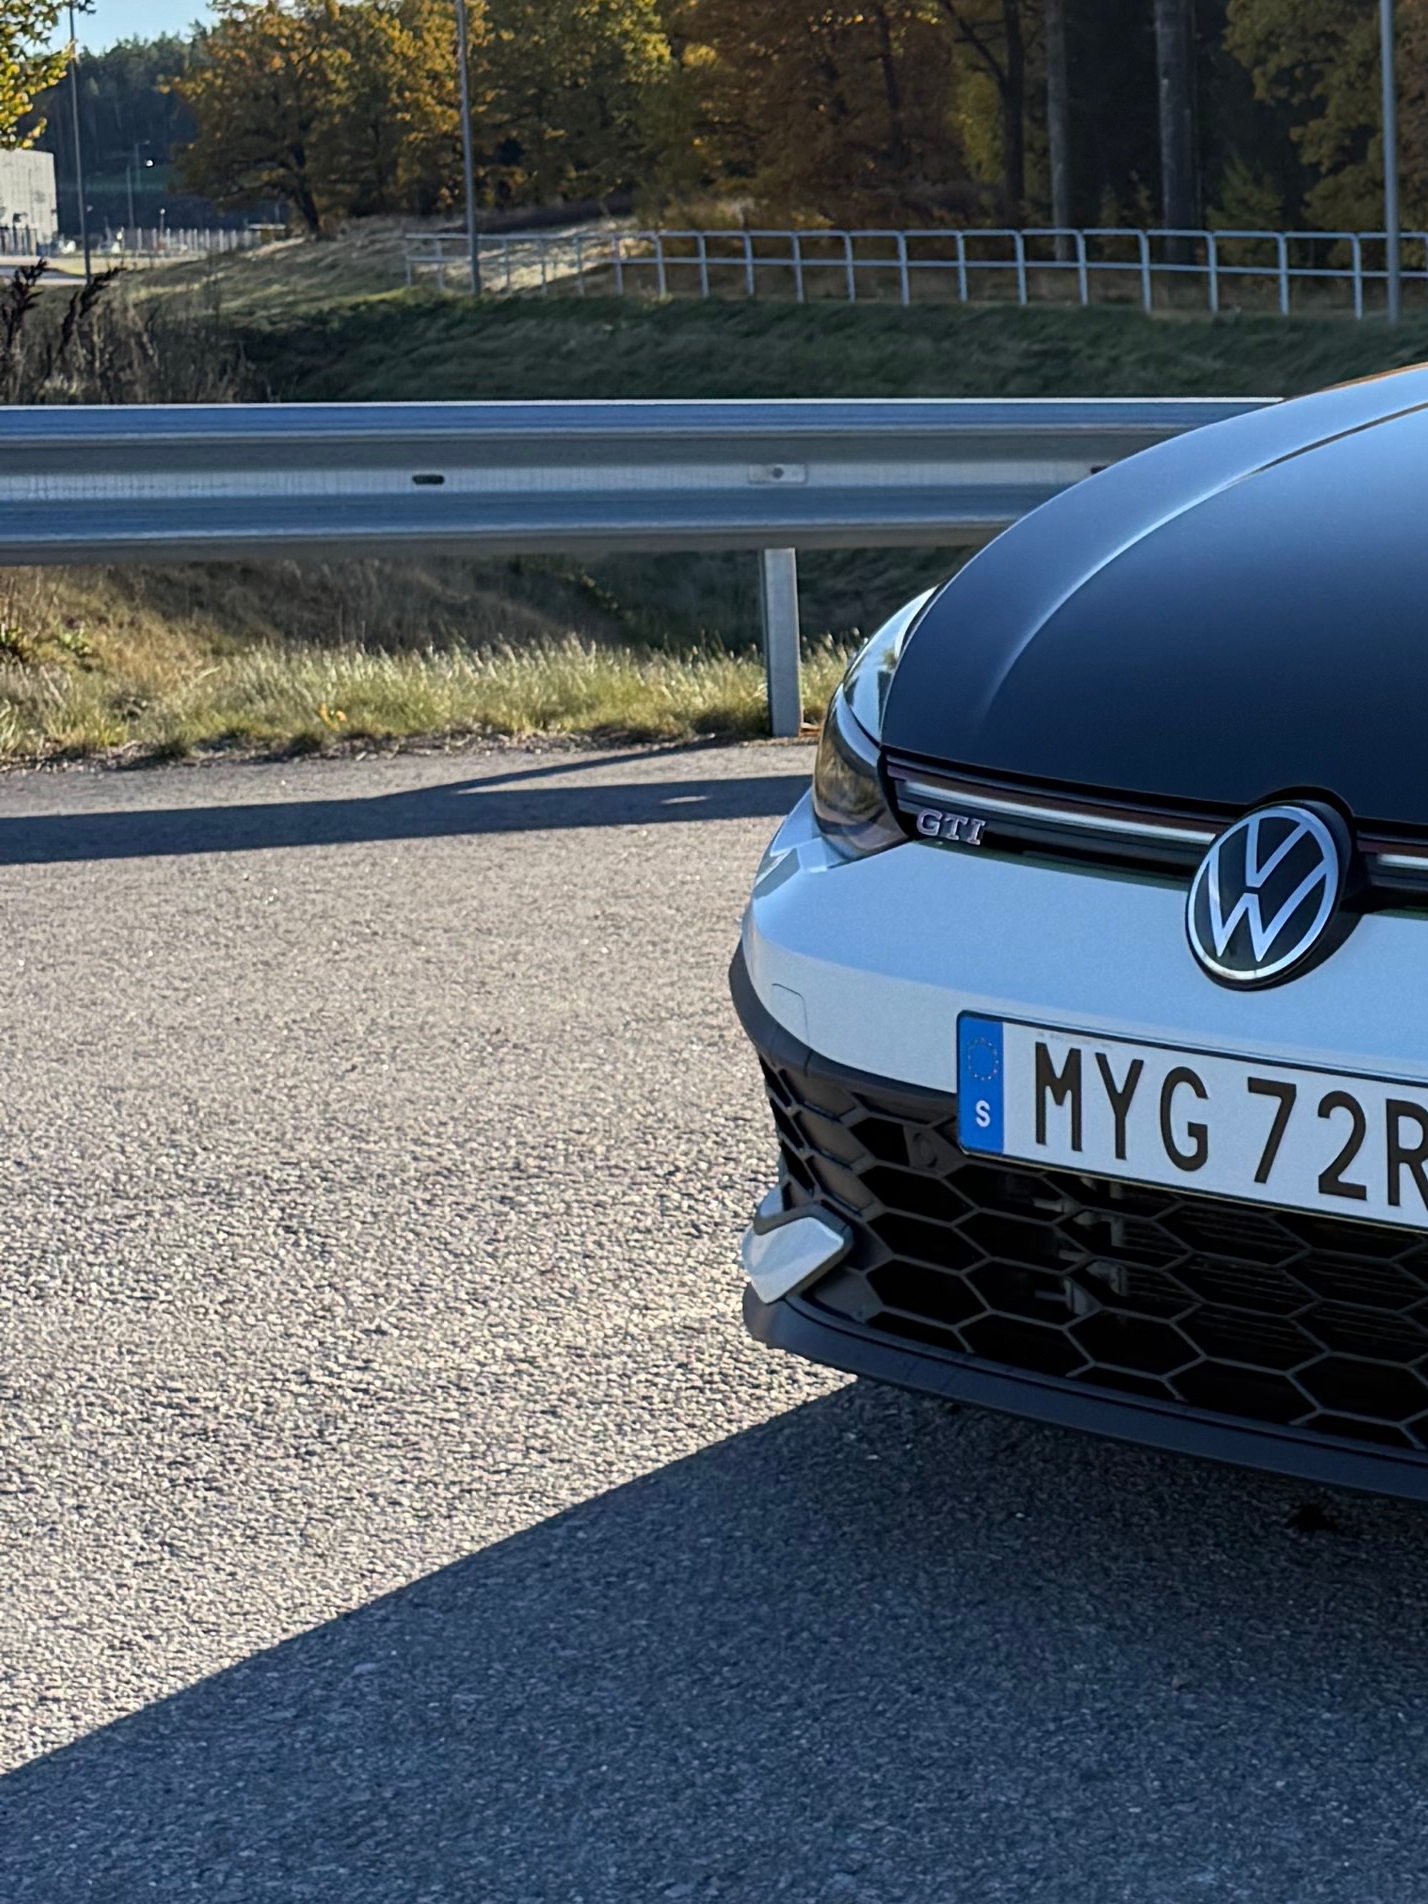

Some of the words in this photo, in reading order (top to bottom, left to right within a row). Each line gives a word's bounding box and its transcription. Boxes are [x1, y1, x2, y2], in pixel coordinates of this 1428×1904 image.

[916, 807, 986, 846] GTI
[1198, 808, 1334, 967] VW
[974, 1099, 992, 1128] S
[1034, 1041, 1209, 1172] MYG
